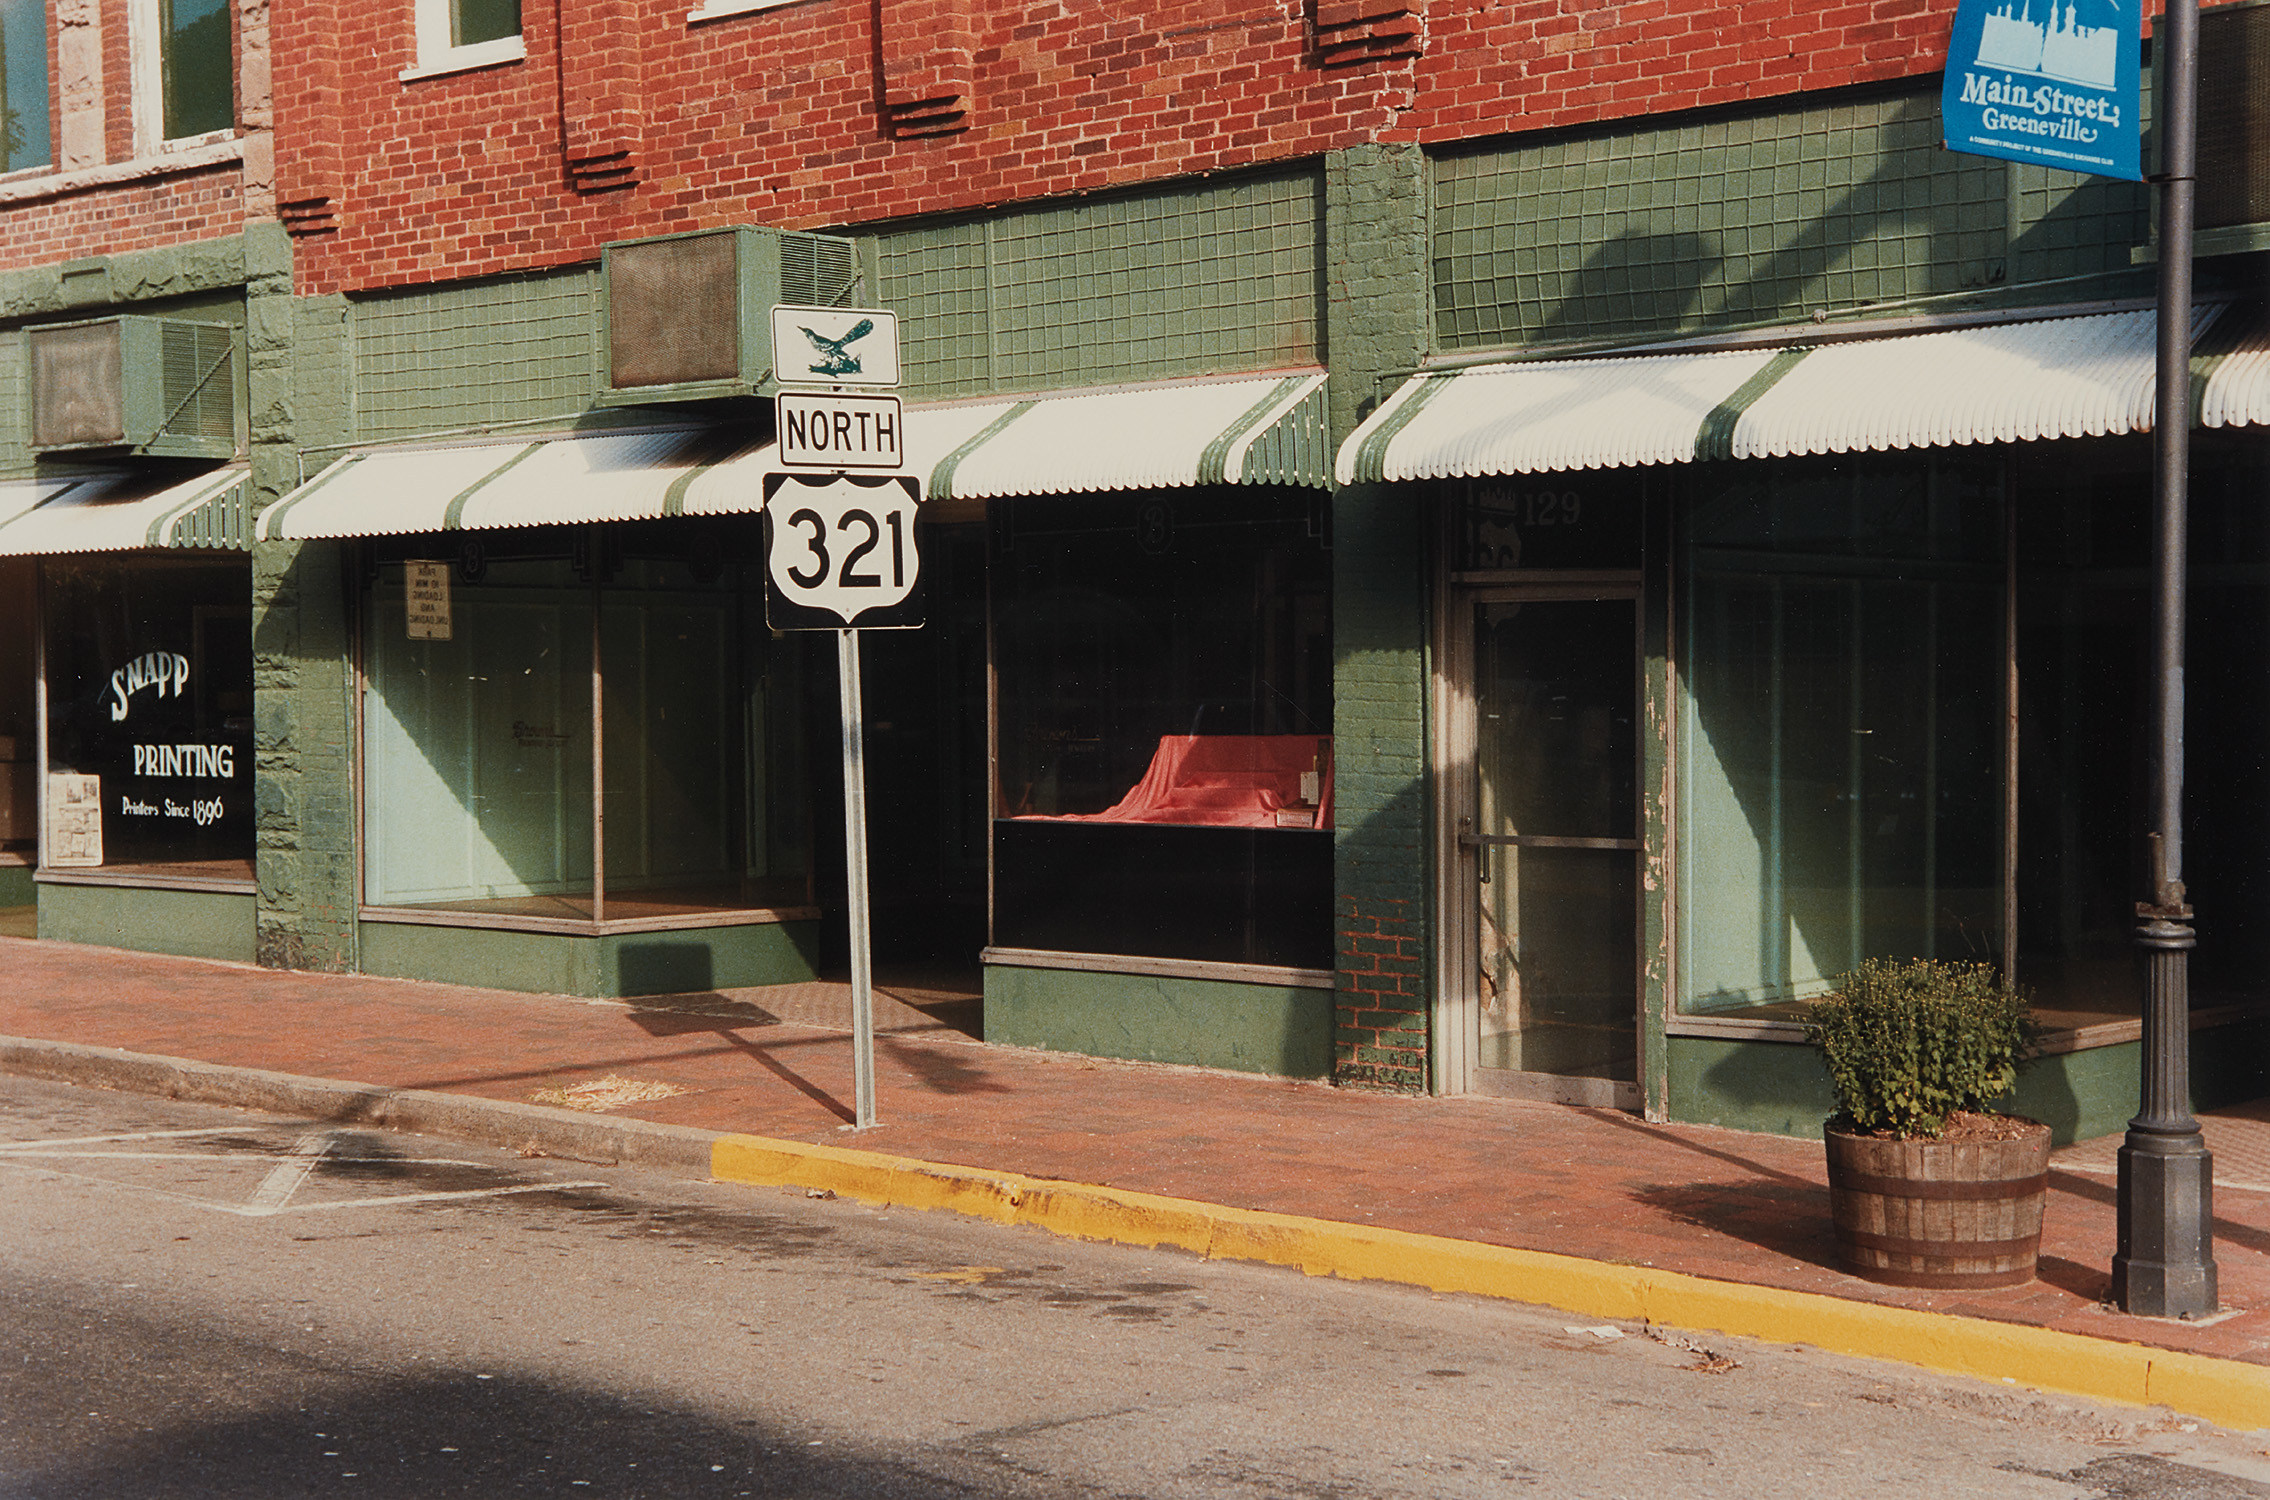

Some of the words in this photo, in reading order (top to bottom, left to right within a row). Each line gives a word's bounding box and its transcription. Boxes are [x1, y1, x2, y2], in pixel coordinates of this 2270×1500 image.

[1960, 72, 2035, 107] Main
[2031, 86, 2120, 127] Street
[1982, 107, 2098, 143] Greeneville
[787, 409, 895, 453] NORTH
[1524, 490, 1581, 526] 129
[786, 508, 905, 589] 321
[111, 651, 189, 722] SNAPP
[133, 744, 234, 778] PRINTING
[122, 796, 159, 816] Printers
[164, 797, 190, 818] Since
[193, 796, 224, 826] 1896
